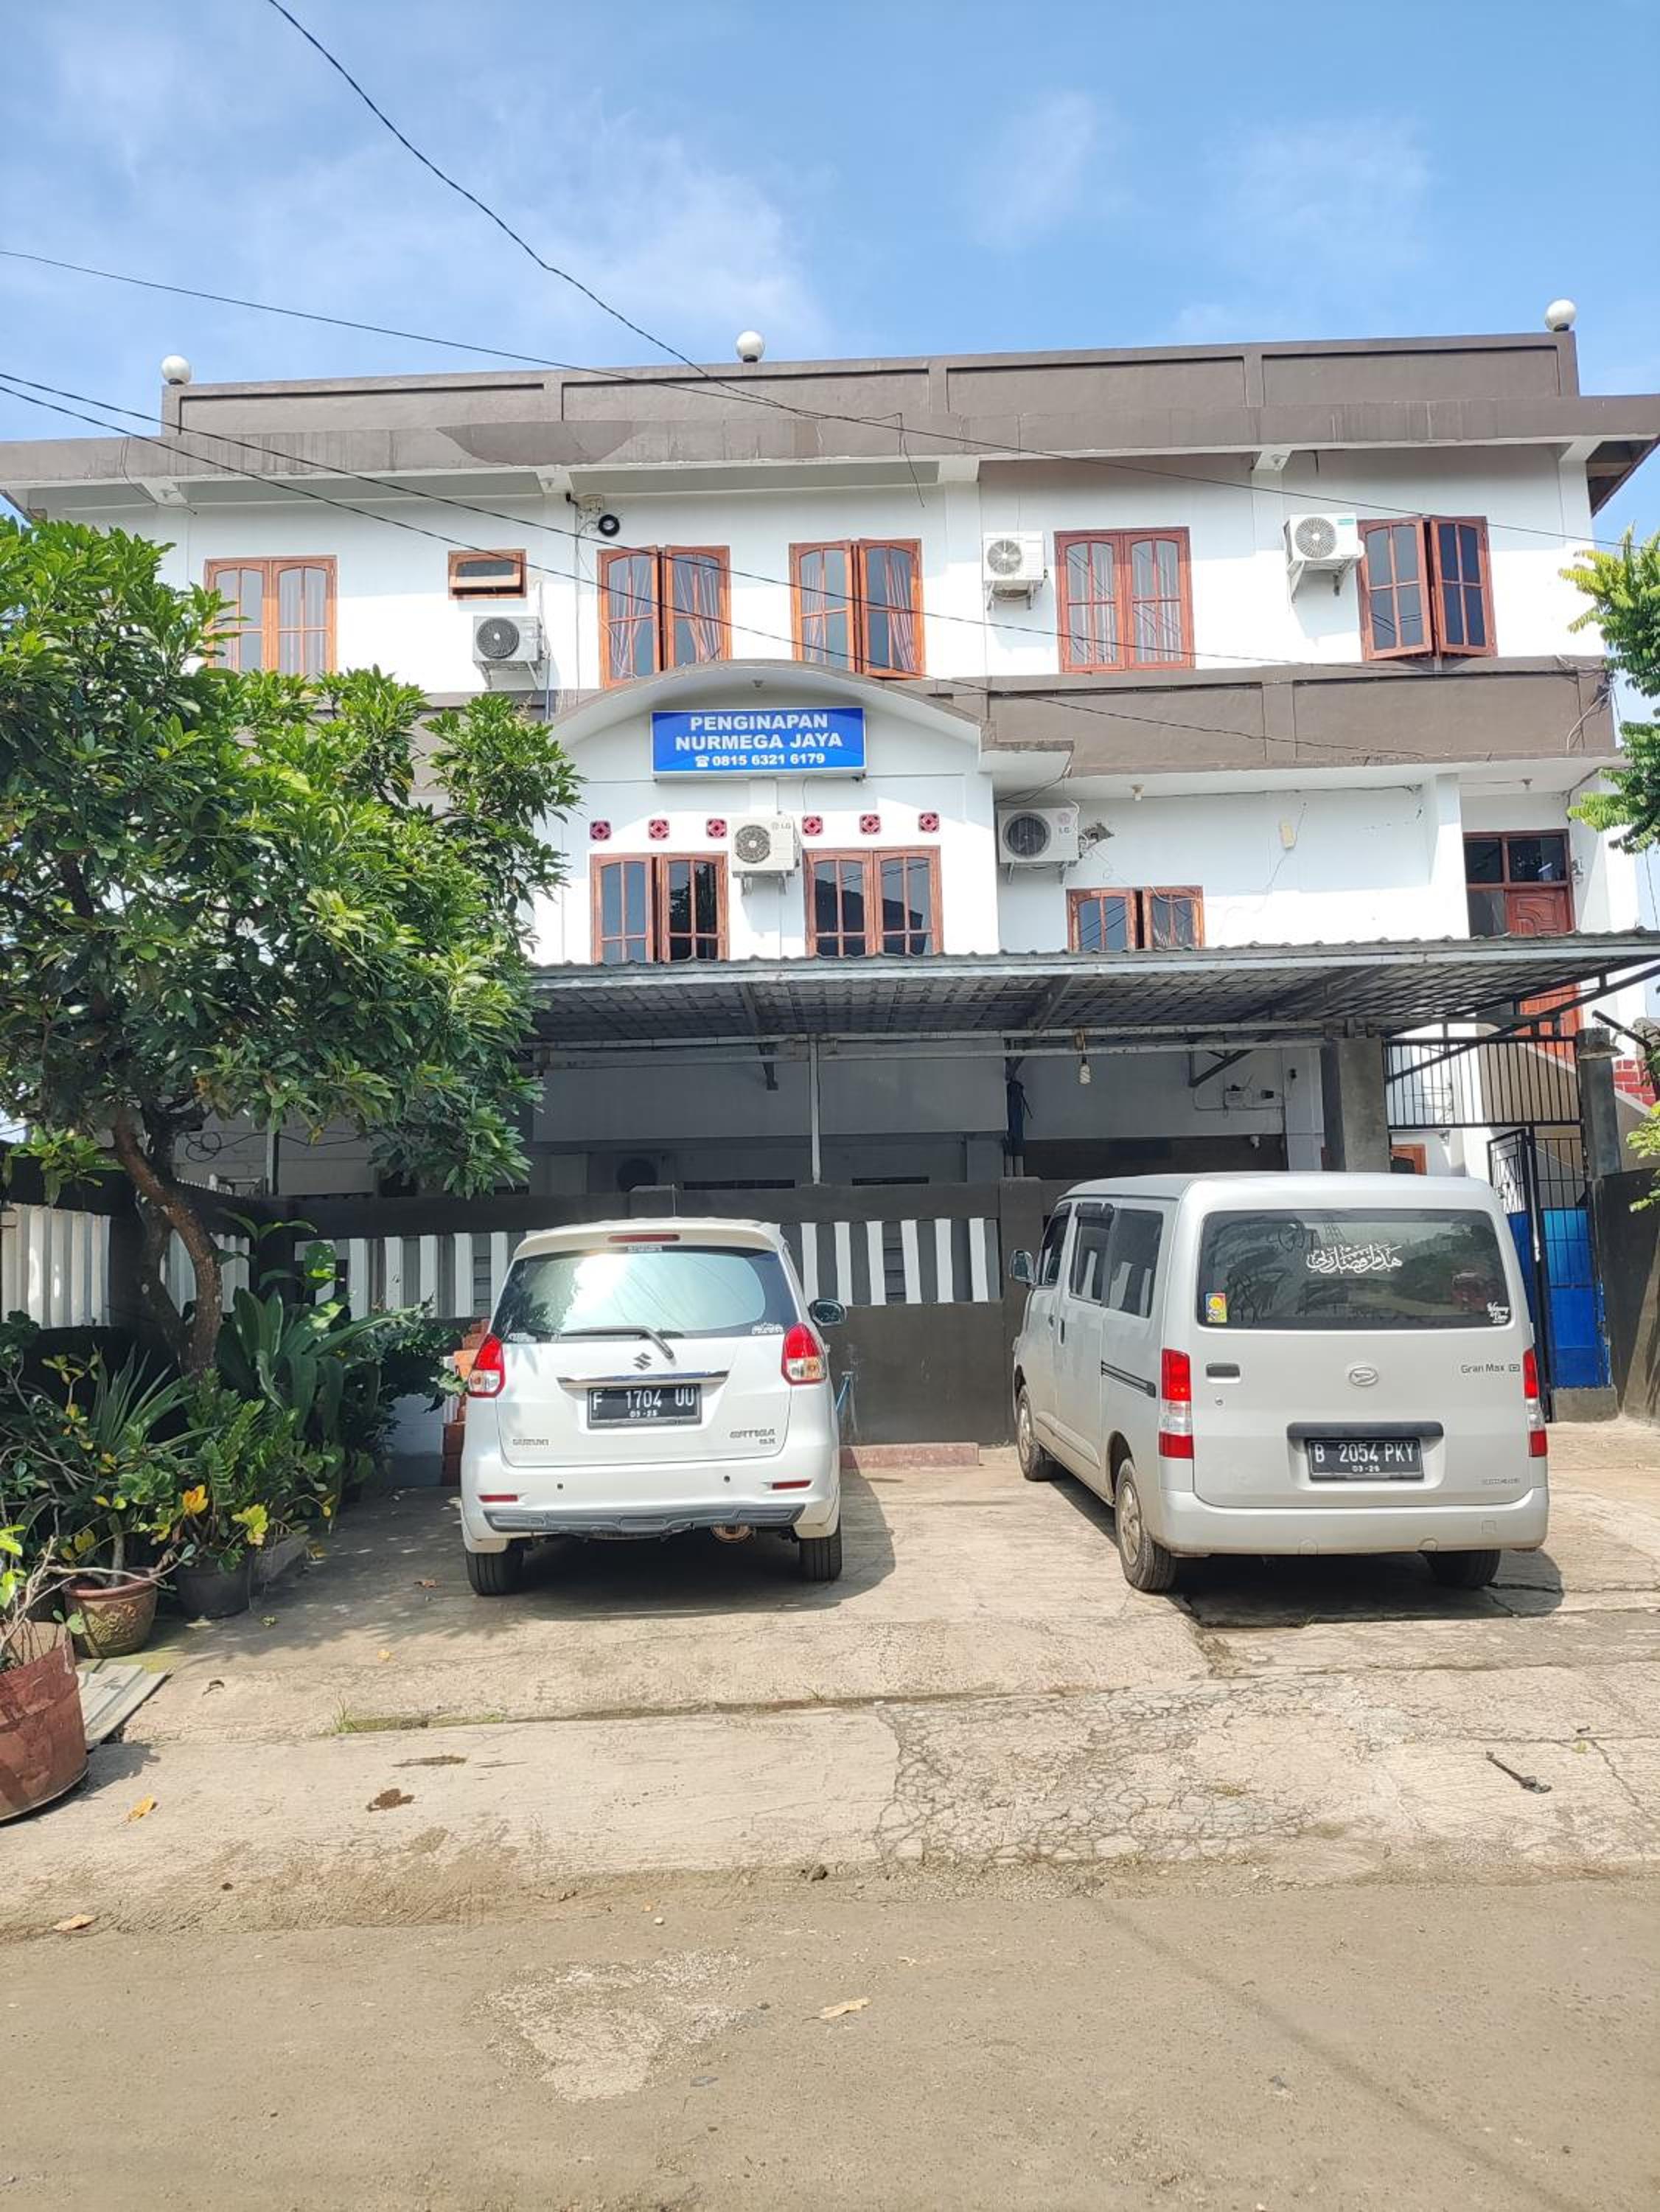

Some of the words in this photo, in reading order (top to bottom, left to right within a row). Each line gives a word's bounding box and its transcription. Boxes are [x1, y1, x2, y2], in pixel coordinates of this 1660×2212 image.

[690, 714, 828, 731] PENGINAPAN
[675, 734, 783, 751] NURMEGA
[789, 732, 843, 748] JAYA
[712, 755, 747, 766] 0815
[751, 754, 785, 765] 6321
[789, 753, 826, 765] 6179
[1461, 1364, 1483, 1374] Gran
[1485, 1363, 1505, 1372] Max
[593, 1391, 603, 1411] F
[625, 1389, 662, 1409] 1704
[674, 1388, 694, 1407] UU
[1314, 1444, 1325, 1462] B
[1338, 1444, 1379, 1462] 2054
[1384, 1443, 1415, 1462] PKY
